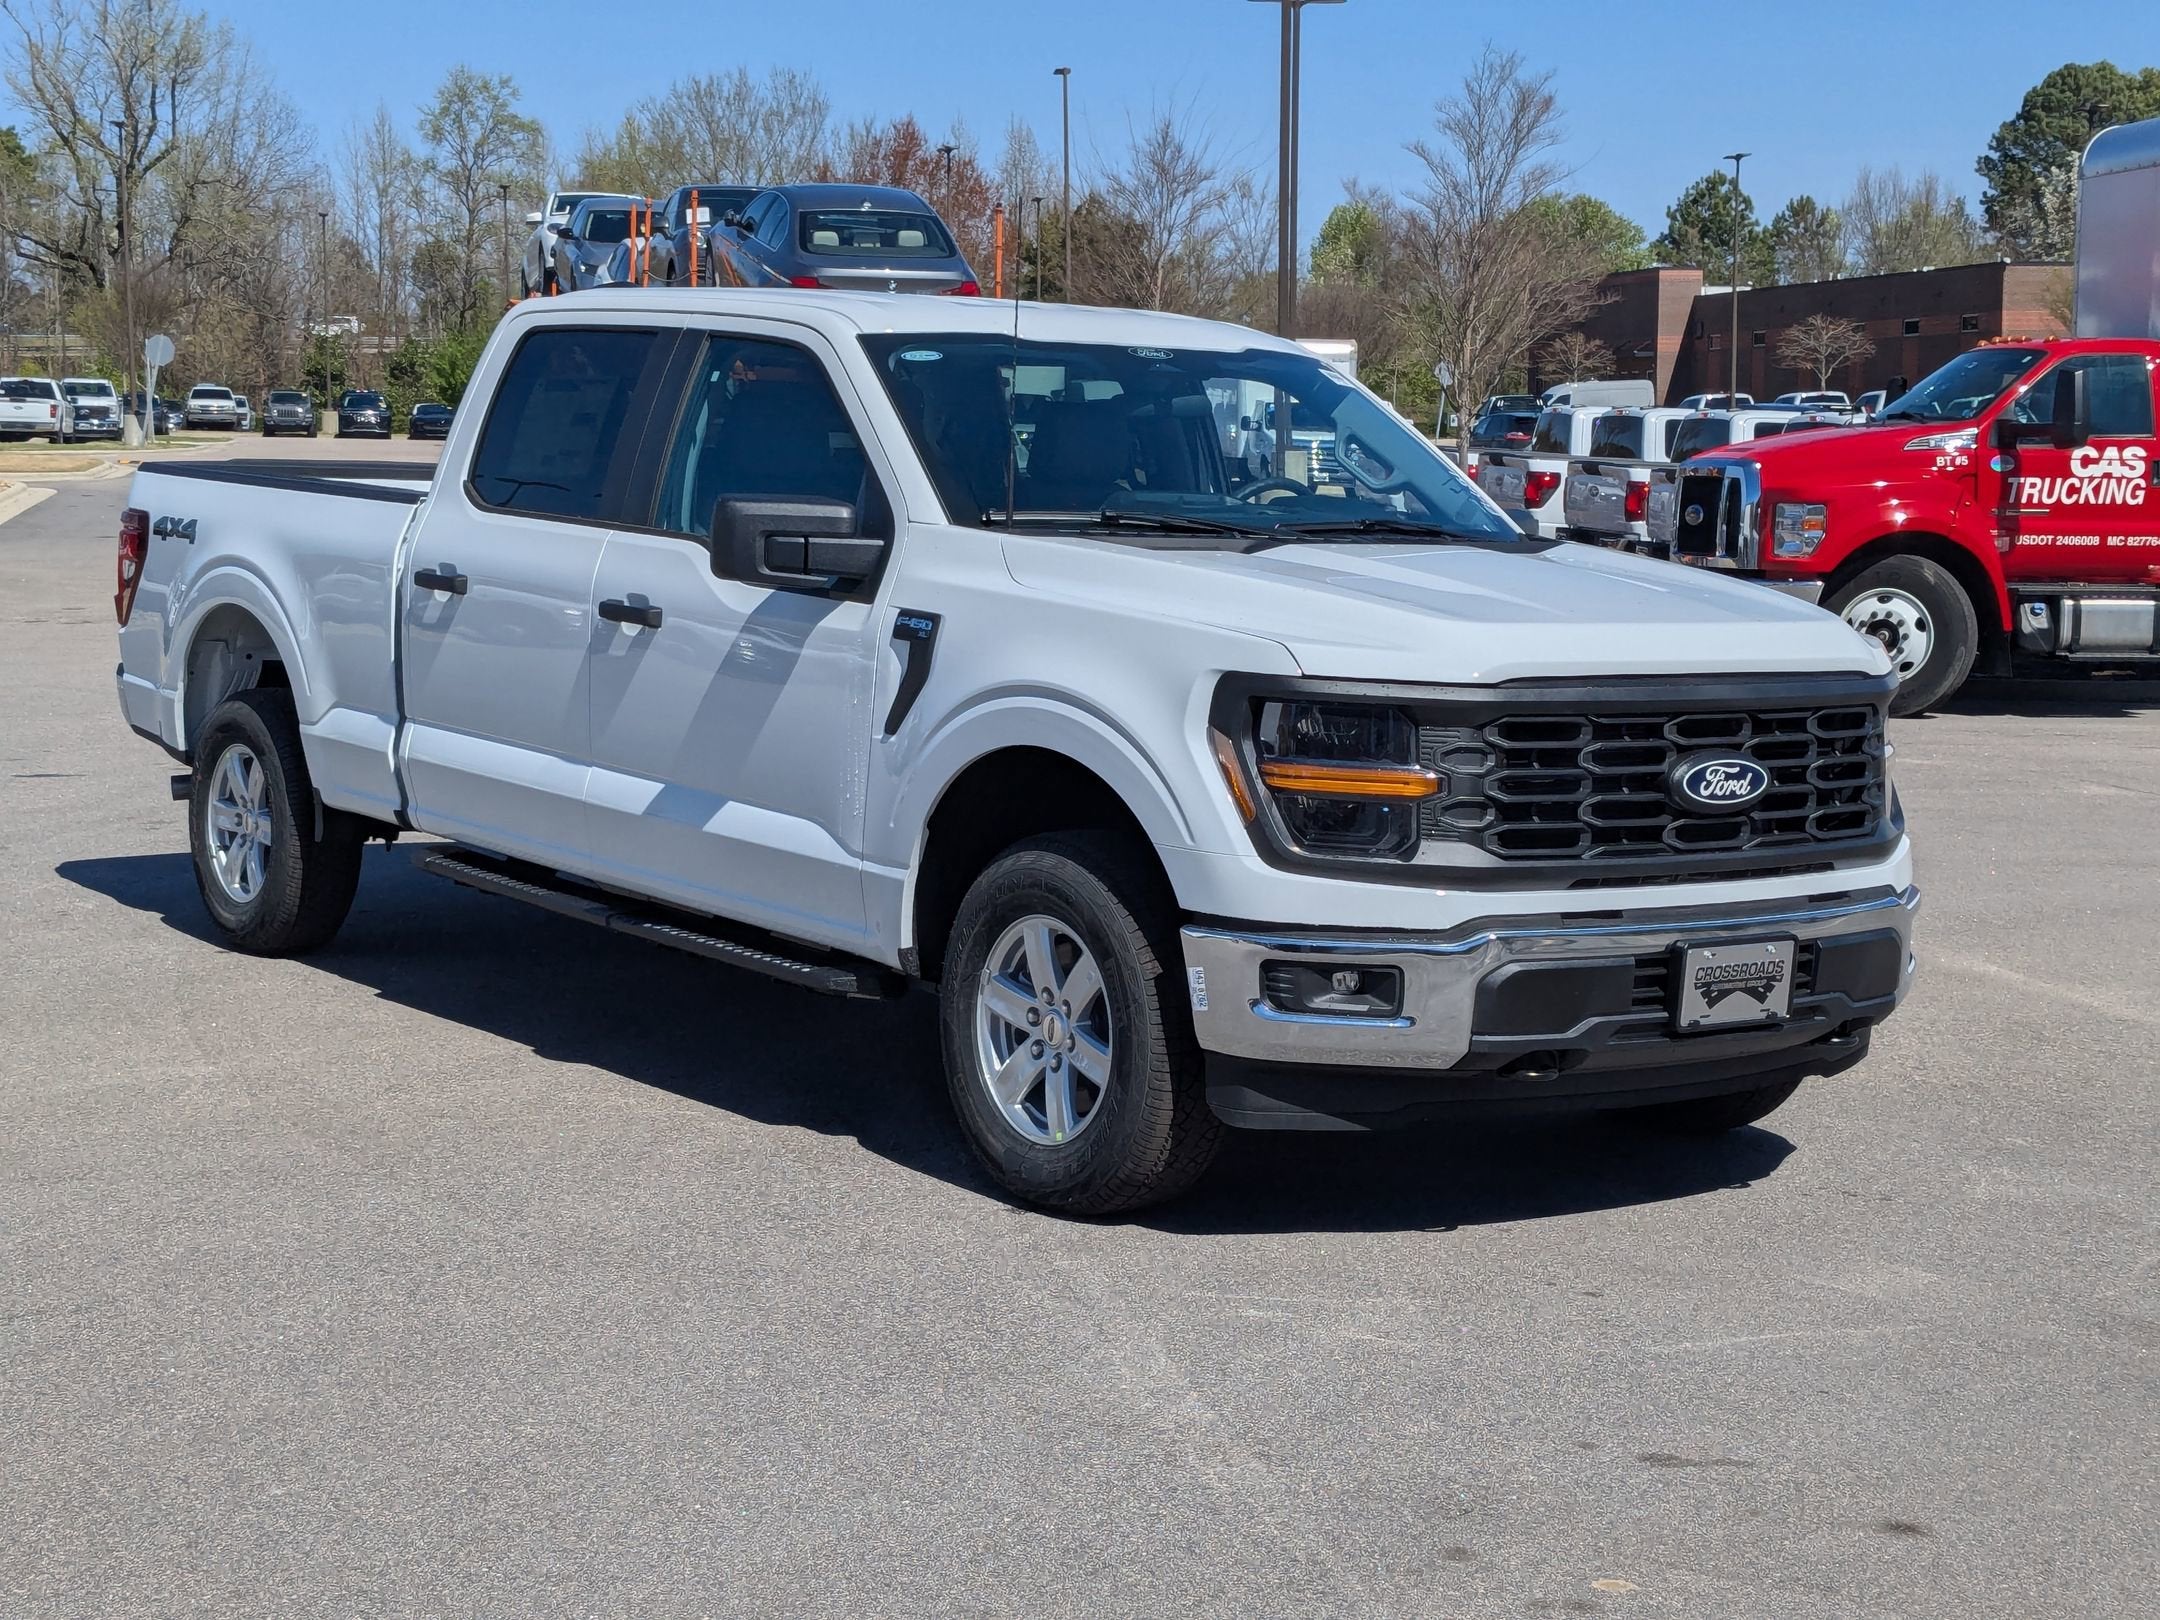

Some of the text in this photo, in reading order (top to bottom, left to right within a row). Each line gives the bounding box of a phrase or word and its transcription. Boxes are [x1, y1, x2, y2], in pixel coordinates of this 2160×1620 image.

[1936, 455, 1969, 467] BT #5
[2070, 446, 2147, 478] CAS
[2008, 477, 2146, 505] TRUCKING
[2015, 534, 2054, 546] USDOT
[2056, 535, 2100, 546] 2406008
[2107, 535, 2125, 546] MC
[1700, 765, 1753, 797] Ford
[1694, 959, 1785, 982] CROSSROADS
